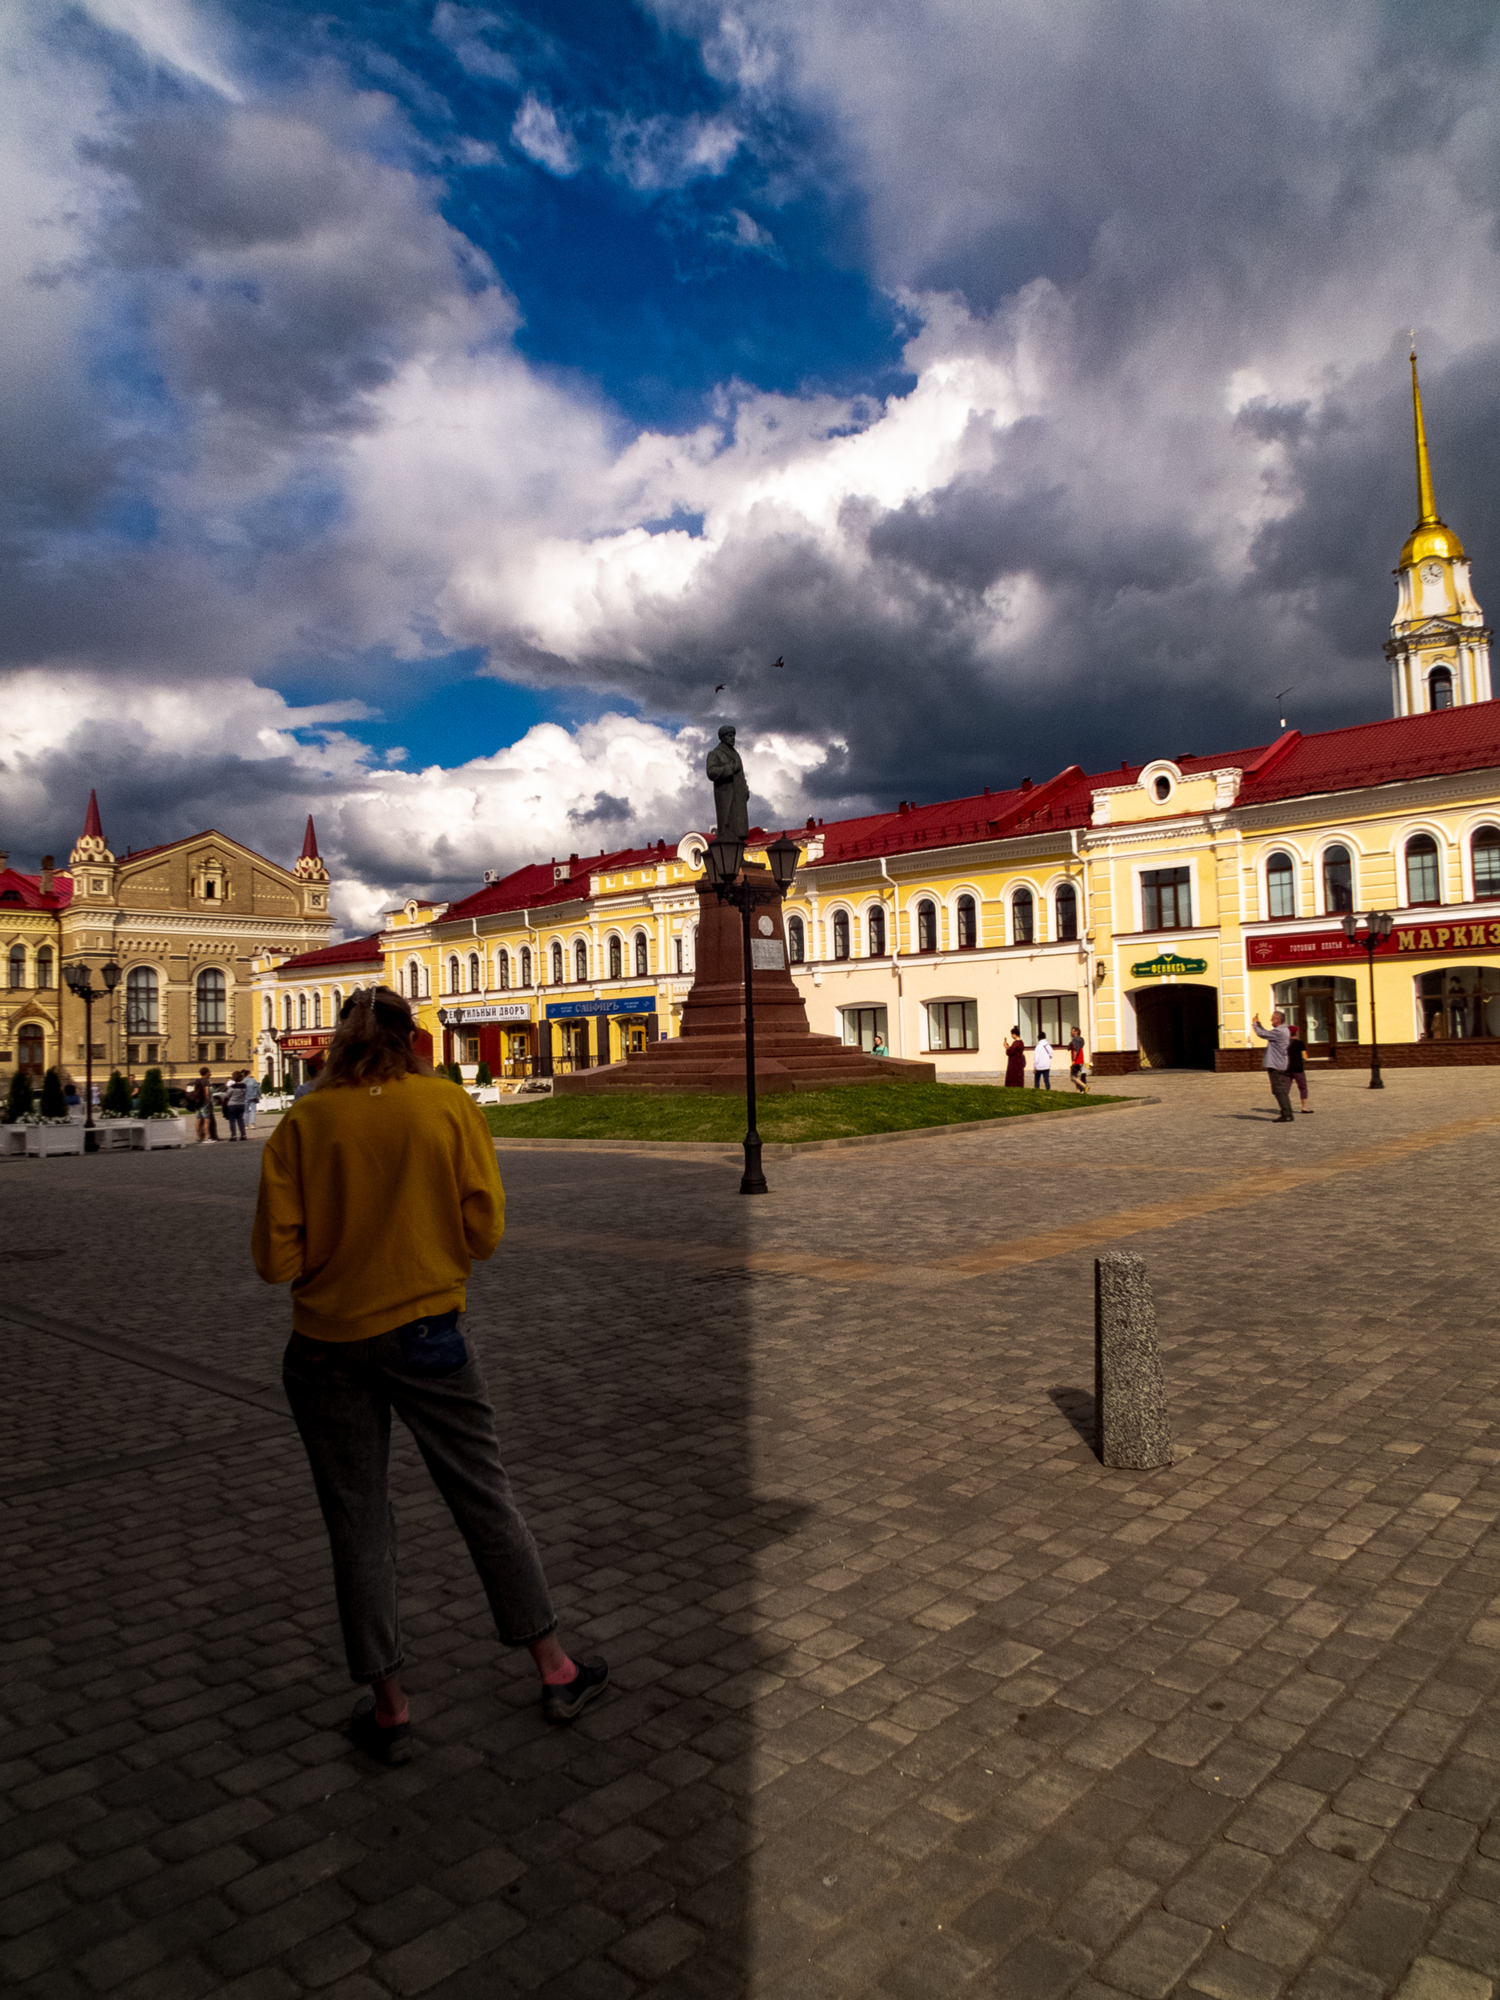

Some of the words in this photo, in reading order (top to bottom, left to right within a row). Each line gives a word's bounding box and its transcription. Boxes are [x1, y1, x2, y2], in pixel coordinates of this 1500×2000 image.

[1397, 923, 1500, 951] МАРКИЗ
[499, 1006, 525, 1016] ДВОРЪ
[574, 1001, 620, 1014] САПФИРЪ
